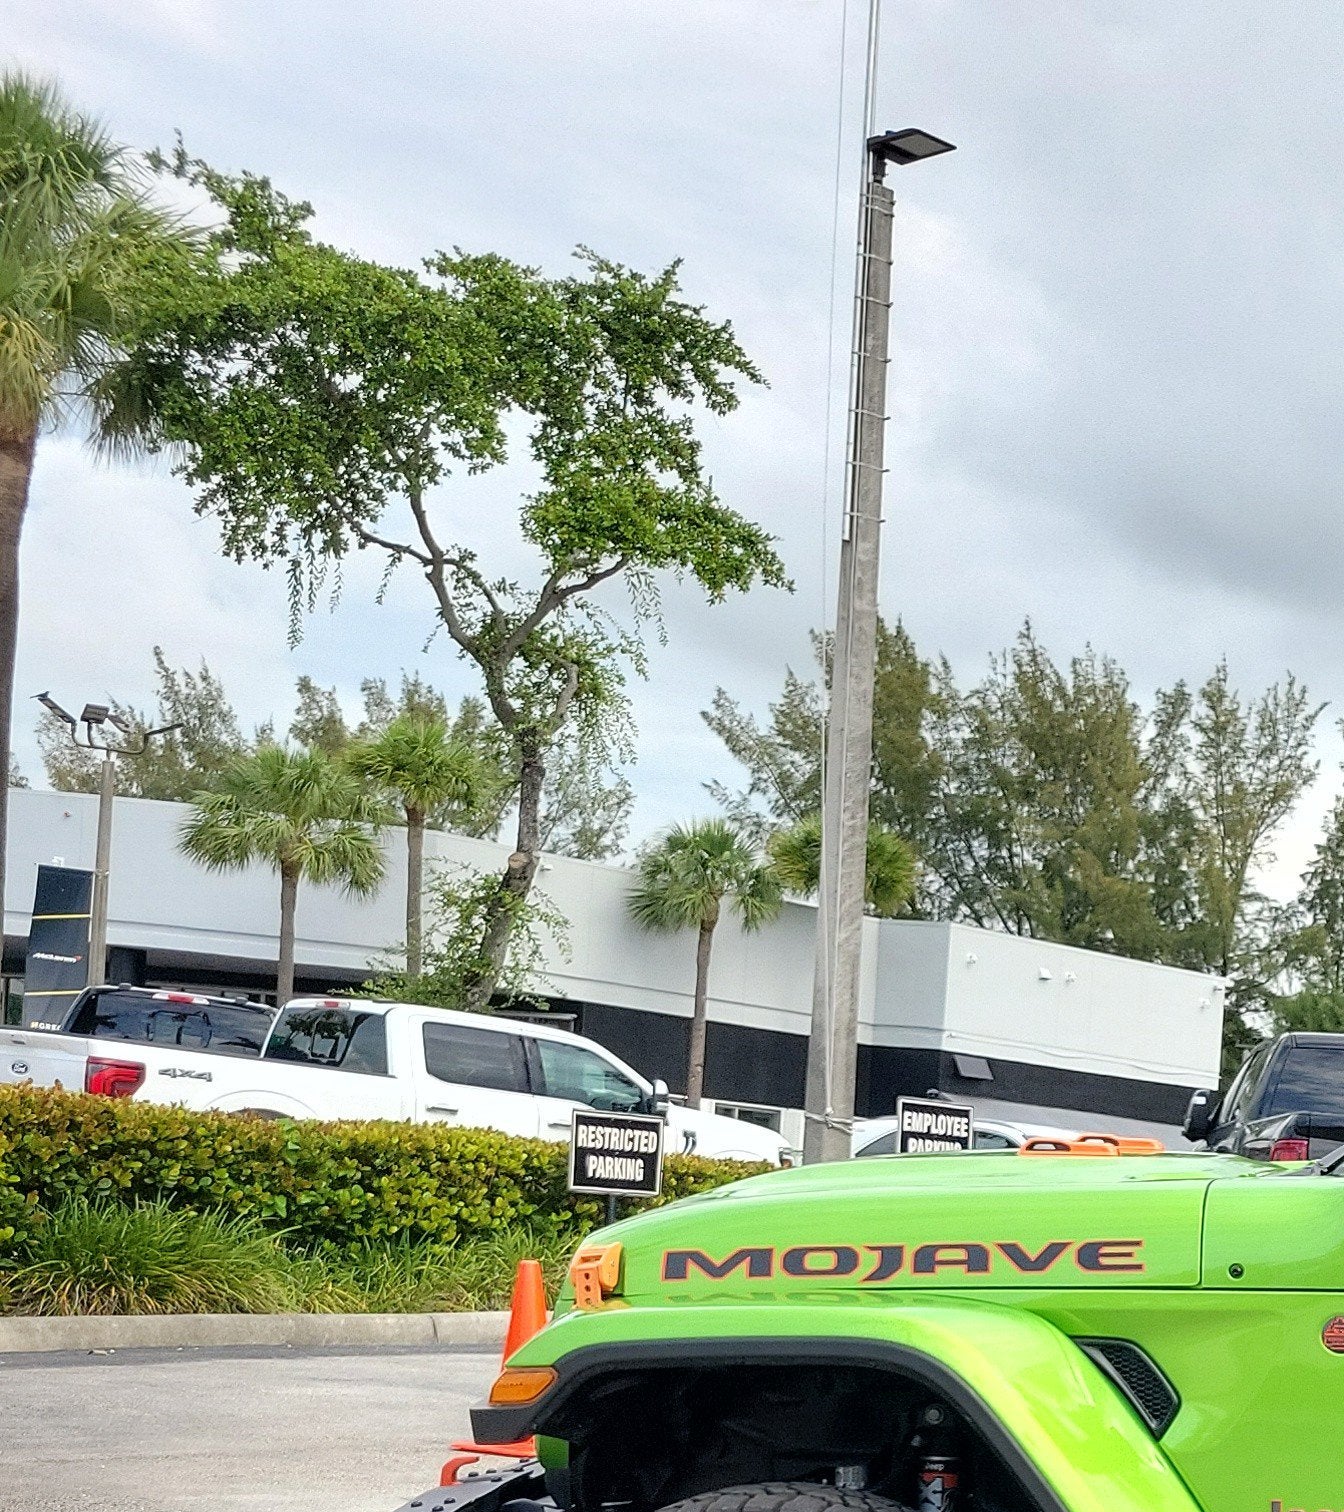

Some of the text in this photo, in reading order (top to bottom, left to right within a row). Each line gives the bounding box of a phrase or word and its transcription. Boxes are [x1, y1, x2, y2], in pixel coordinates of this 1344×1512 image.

[903, 1110, 969, 1138] EMPLOYEE
[577, 1124, 659, 1154] RESTRICTED
[586, 1153, 645, 1182] PARKING
[661, 1239, 1147, 1284] MOJAVE
